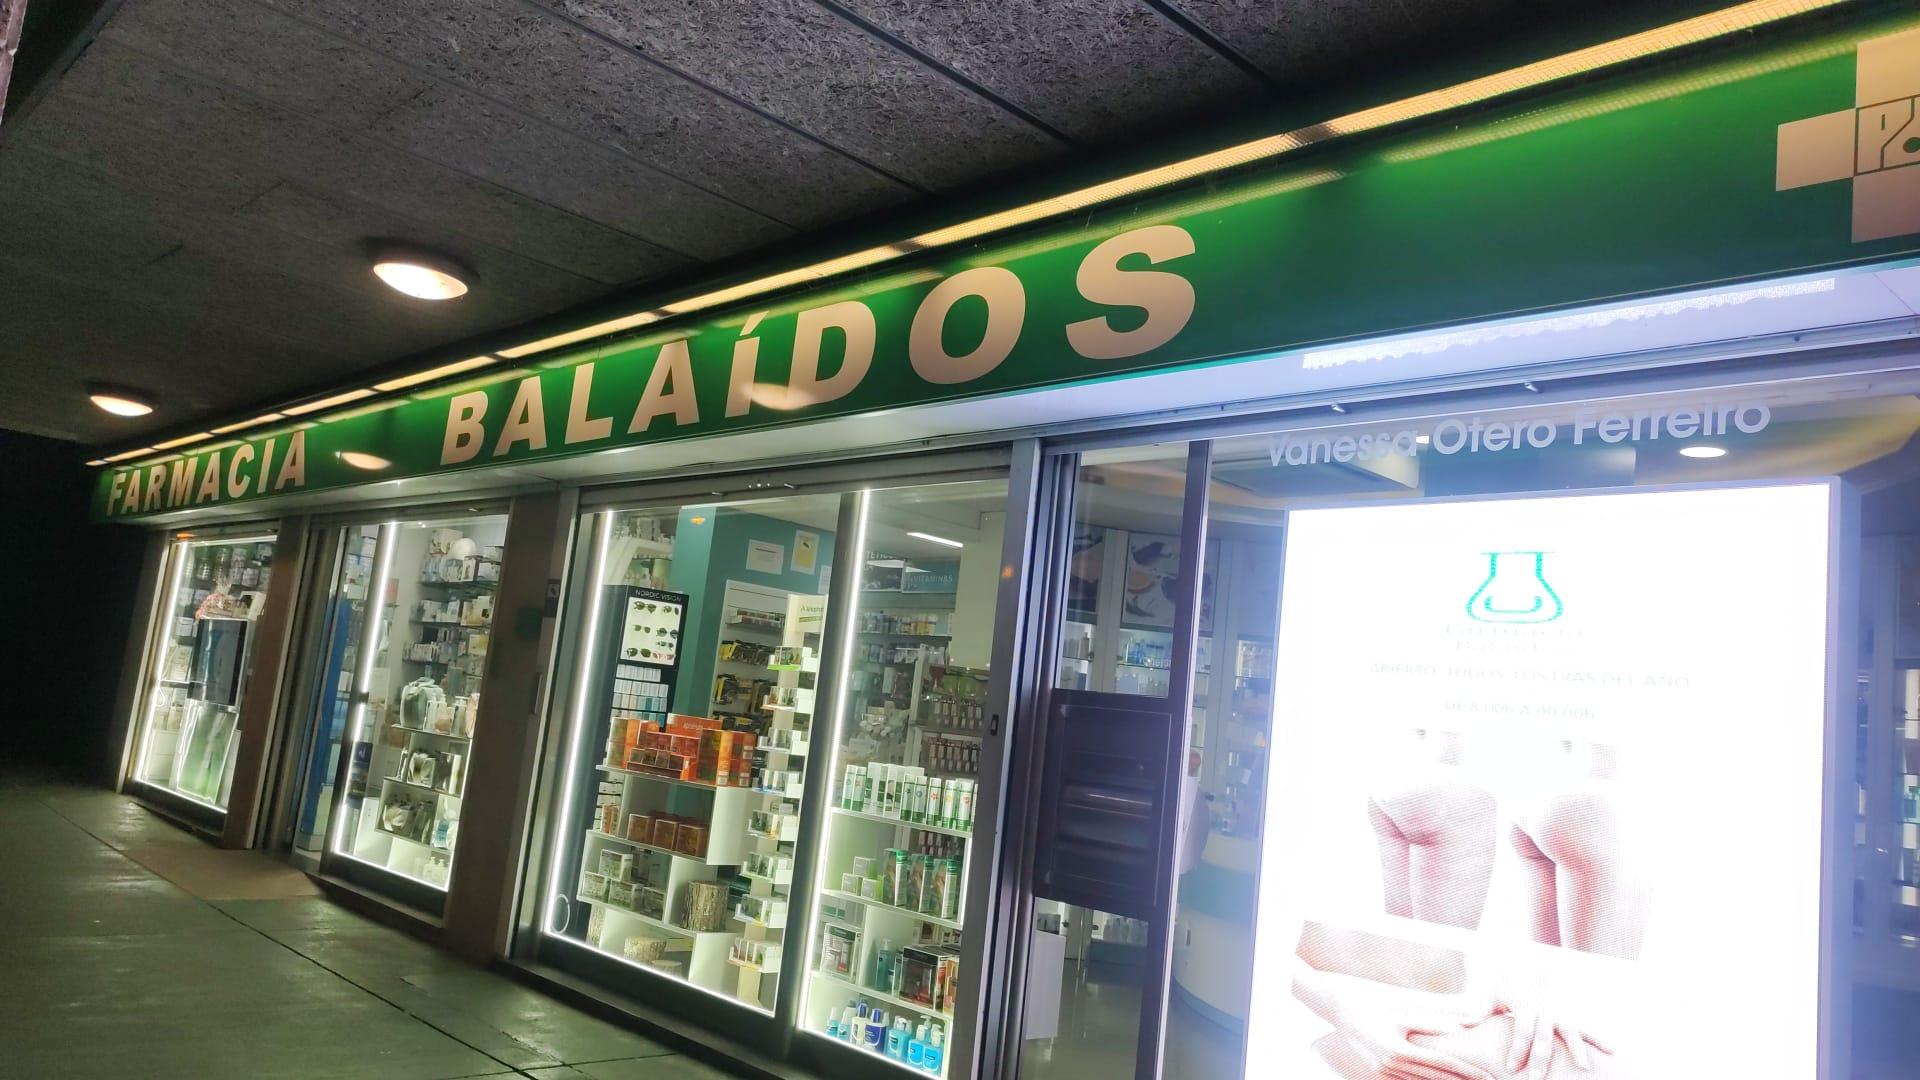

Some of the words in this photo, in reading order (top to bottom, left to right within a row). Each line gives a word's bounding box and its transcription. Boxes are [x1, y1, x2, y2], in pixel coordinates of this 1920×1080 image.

[106, 430, 305, 517] FARMACIA
[440, 225, 1196, 465] BALAÍDOS
[1269, 430, 1418, 467] Vanessa
[1432, 417, 1557, 455] Otero
[1574, 399, 1771, 446] Ferreiro
[635, 588, 660, 599] NORDIC
